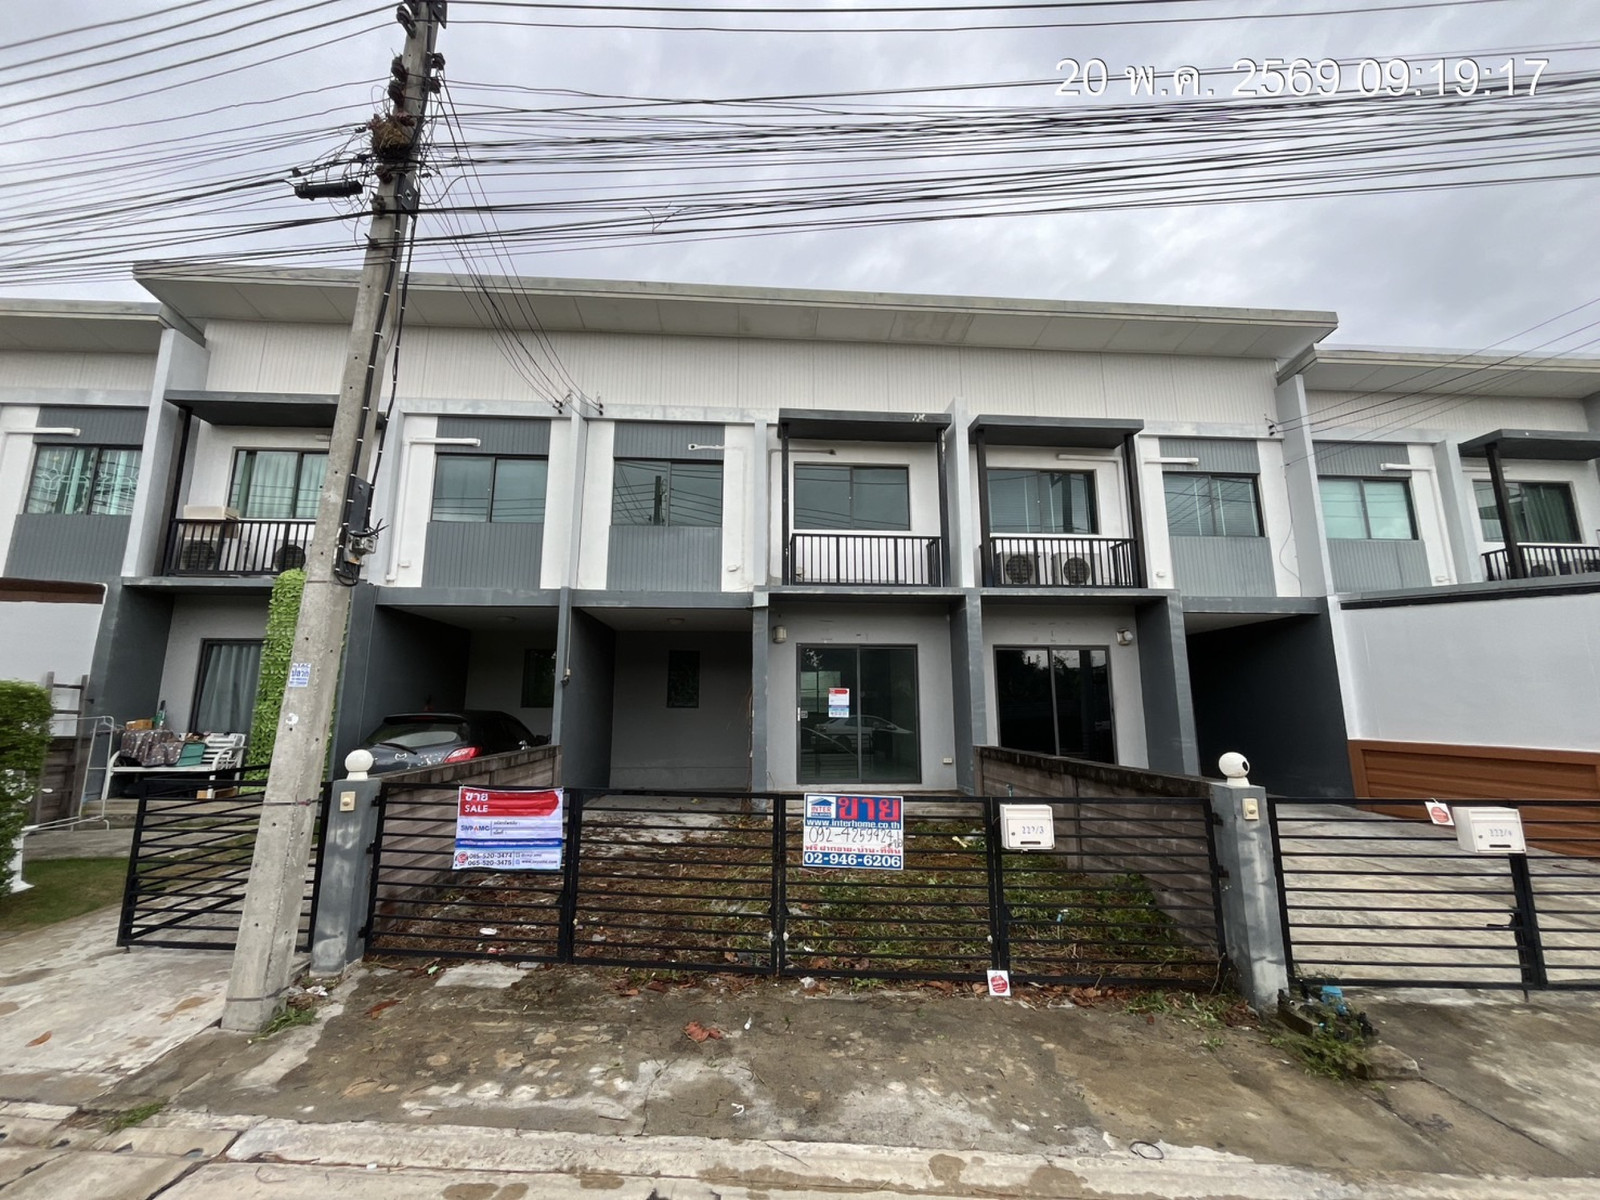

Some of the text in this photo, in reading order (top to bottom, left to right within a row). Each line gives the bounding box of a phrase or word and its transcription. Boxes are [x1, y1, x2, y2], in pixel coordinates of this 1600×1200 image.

[465, 792, 488, 802] ขาย
[465, 805, 489, 813] SALE
[838, 797, 901, 821] ขาย
[806, 818, 901, 830] www.interhome.co.th
[804, 852, 901, 867] 02-946-6206
